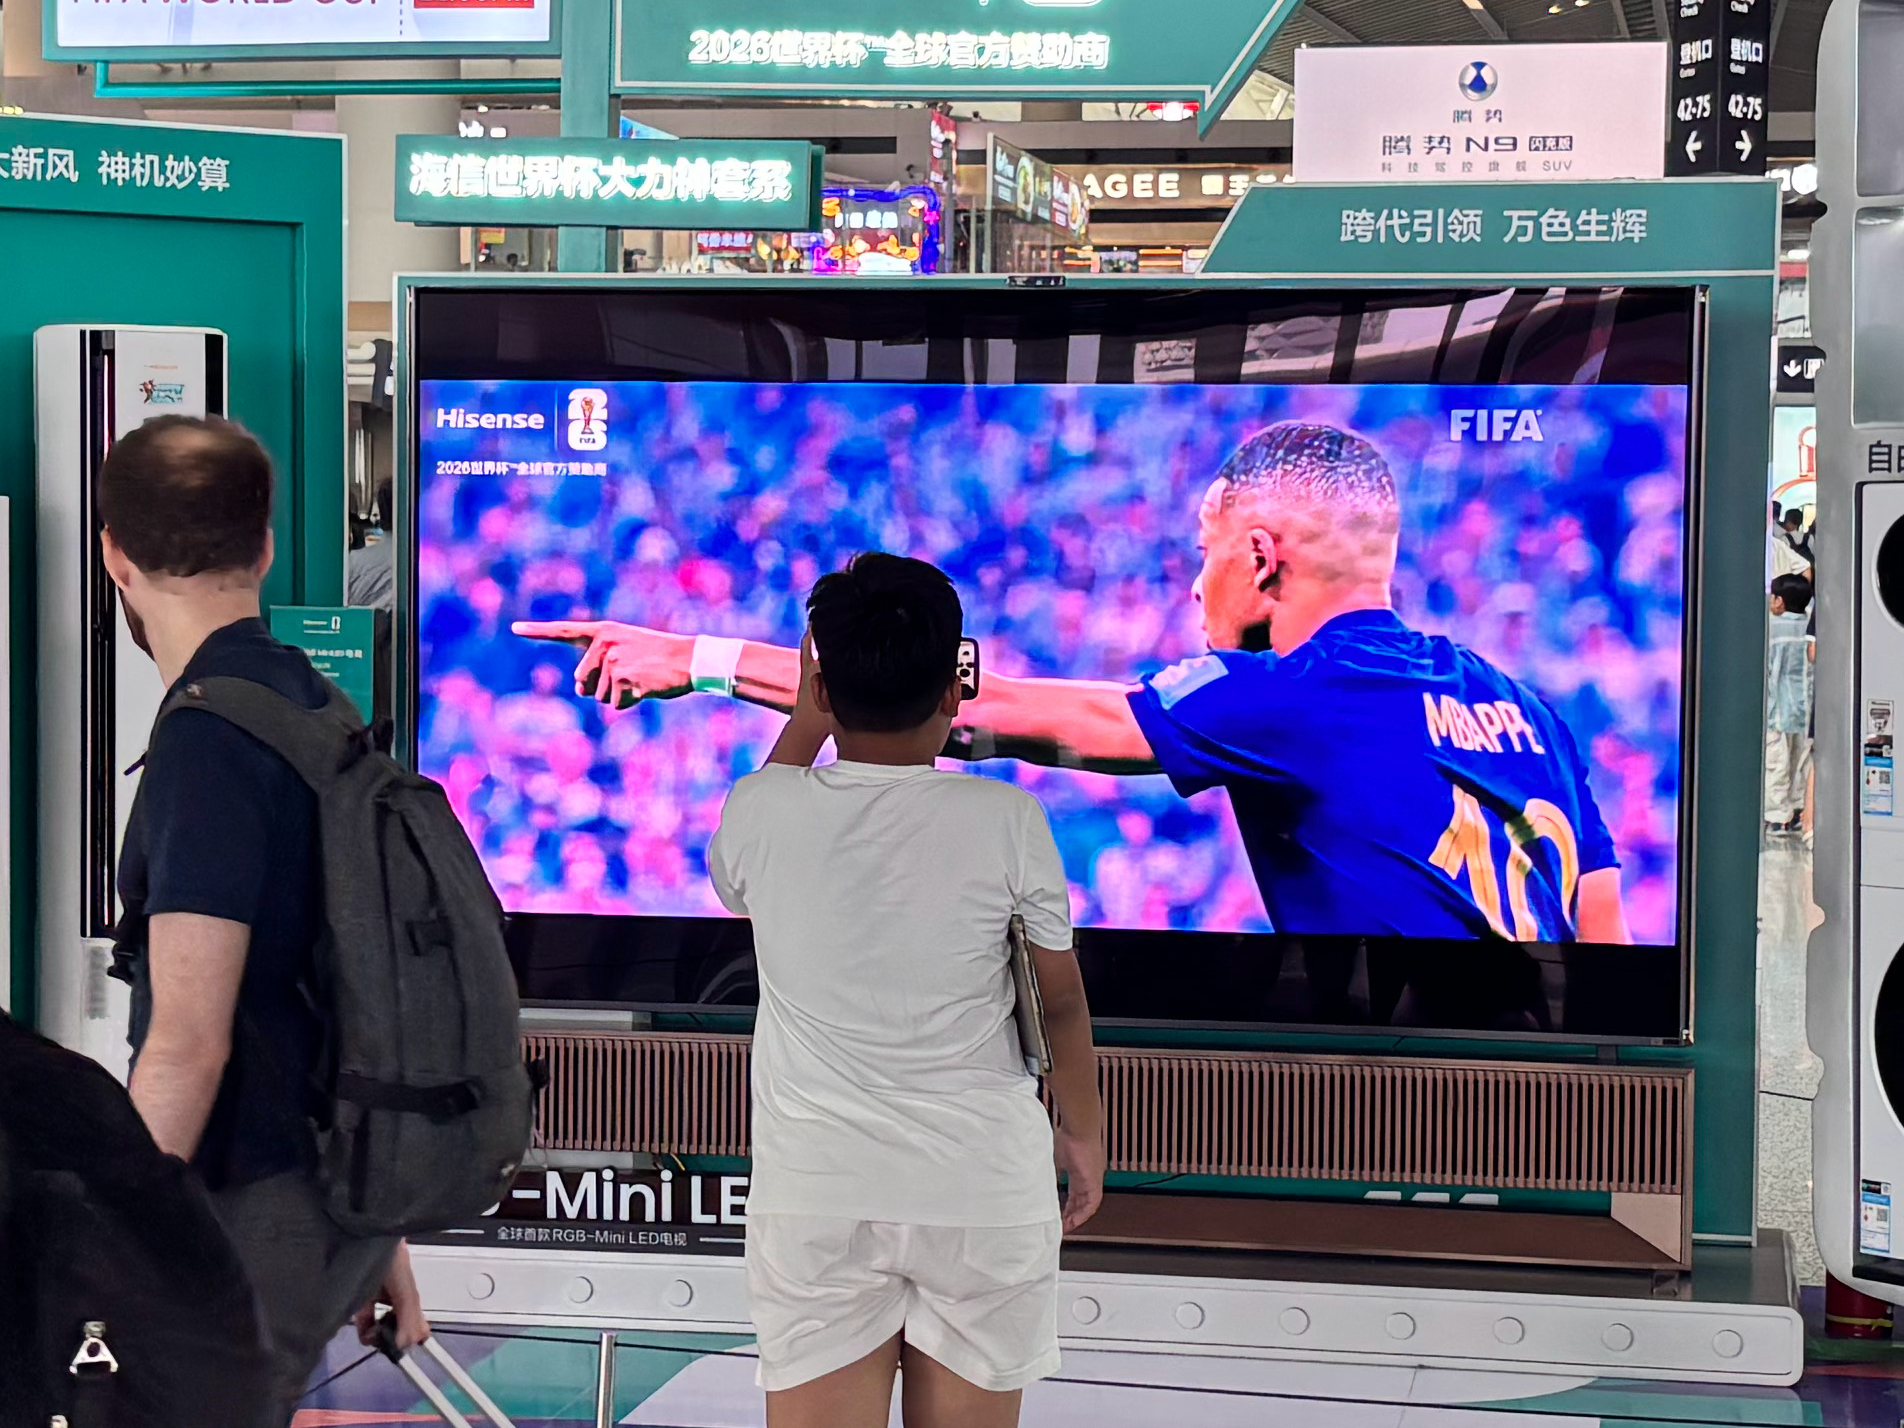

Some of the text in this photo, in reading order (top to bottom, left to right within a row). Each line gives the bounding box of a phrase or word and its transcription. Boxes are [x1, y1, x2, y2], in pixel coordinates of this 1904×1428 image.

[1679, 39, 1712, 65] 登机口
[1730, 38, 1763, 63] 登机口
[1464, 135, 1518, 152] N9
[98, 149, 231, 192] 神机妙算
[409, 153, 792, 201] 海信世界杯大力神套系
[1542, 160, 1573, 172] SUV
[1339, 209, 1648, 244] 跨代引领 万色生辉
[436, 408, 545, 430] Hisense
[1450, 409, 1543, 441] FIFA
[480, 1168, 673, 1222] -Mini
[497, 1226, 688, 1246] 全球首款RGB-Mini LED电视
